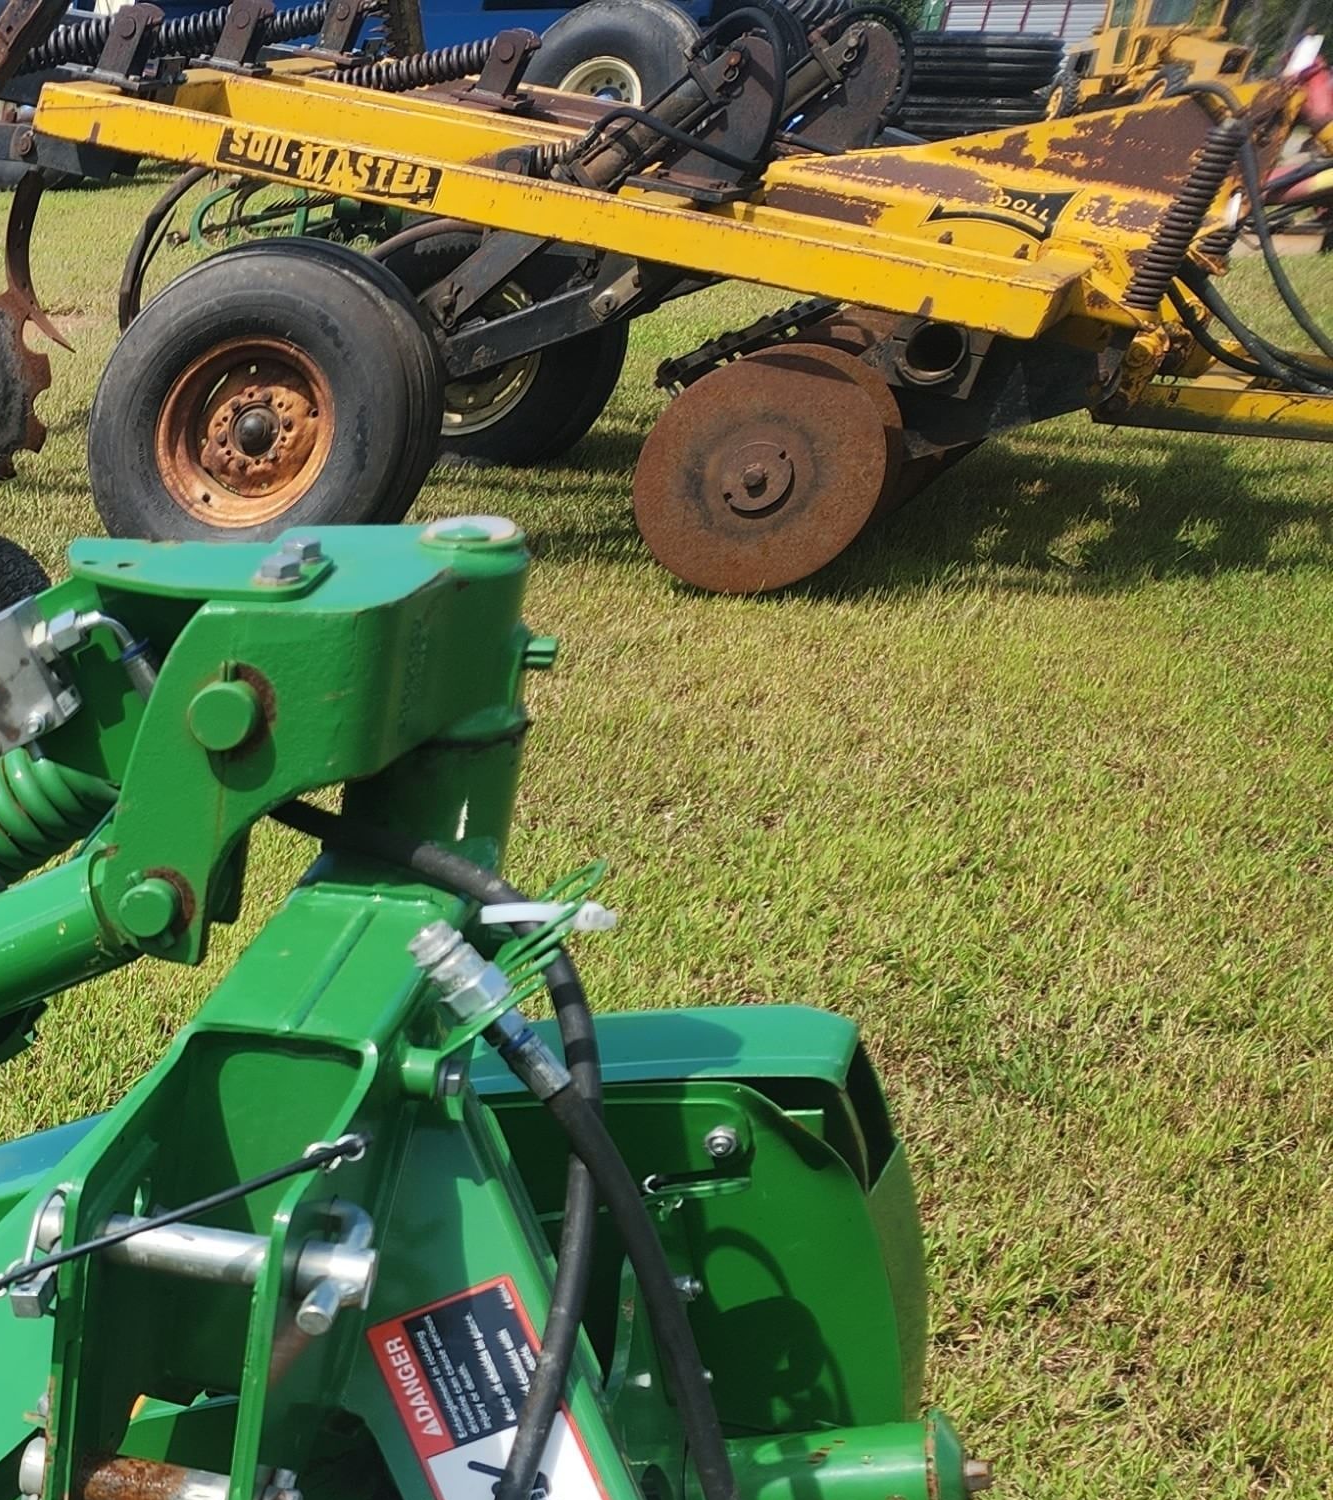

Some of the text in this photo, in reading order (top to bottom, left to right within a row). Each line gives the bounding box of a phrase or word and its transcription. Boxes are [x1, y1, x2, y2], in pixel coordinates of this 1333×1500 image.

[997, 195, 1050, 222] DOLL
[414, 1329, 439, 1366] rotating
[386, 1336, 434, 1422] DANGER
[422, 1314, 480, 1435] driveline can cause serious
[429, 1365, 441, 1376] in
[470, 1390, 480, 1402] or
[497, 1395, 519, 1421] Keep
[473, 1402, 494, 1429] injury
